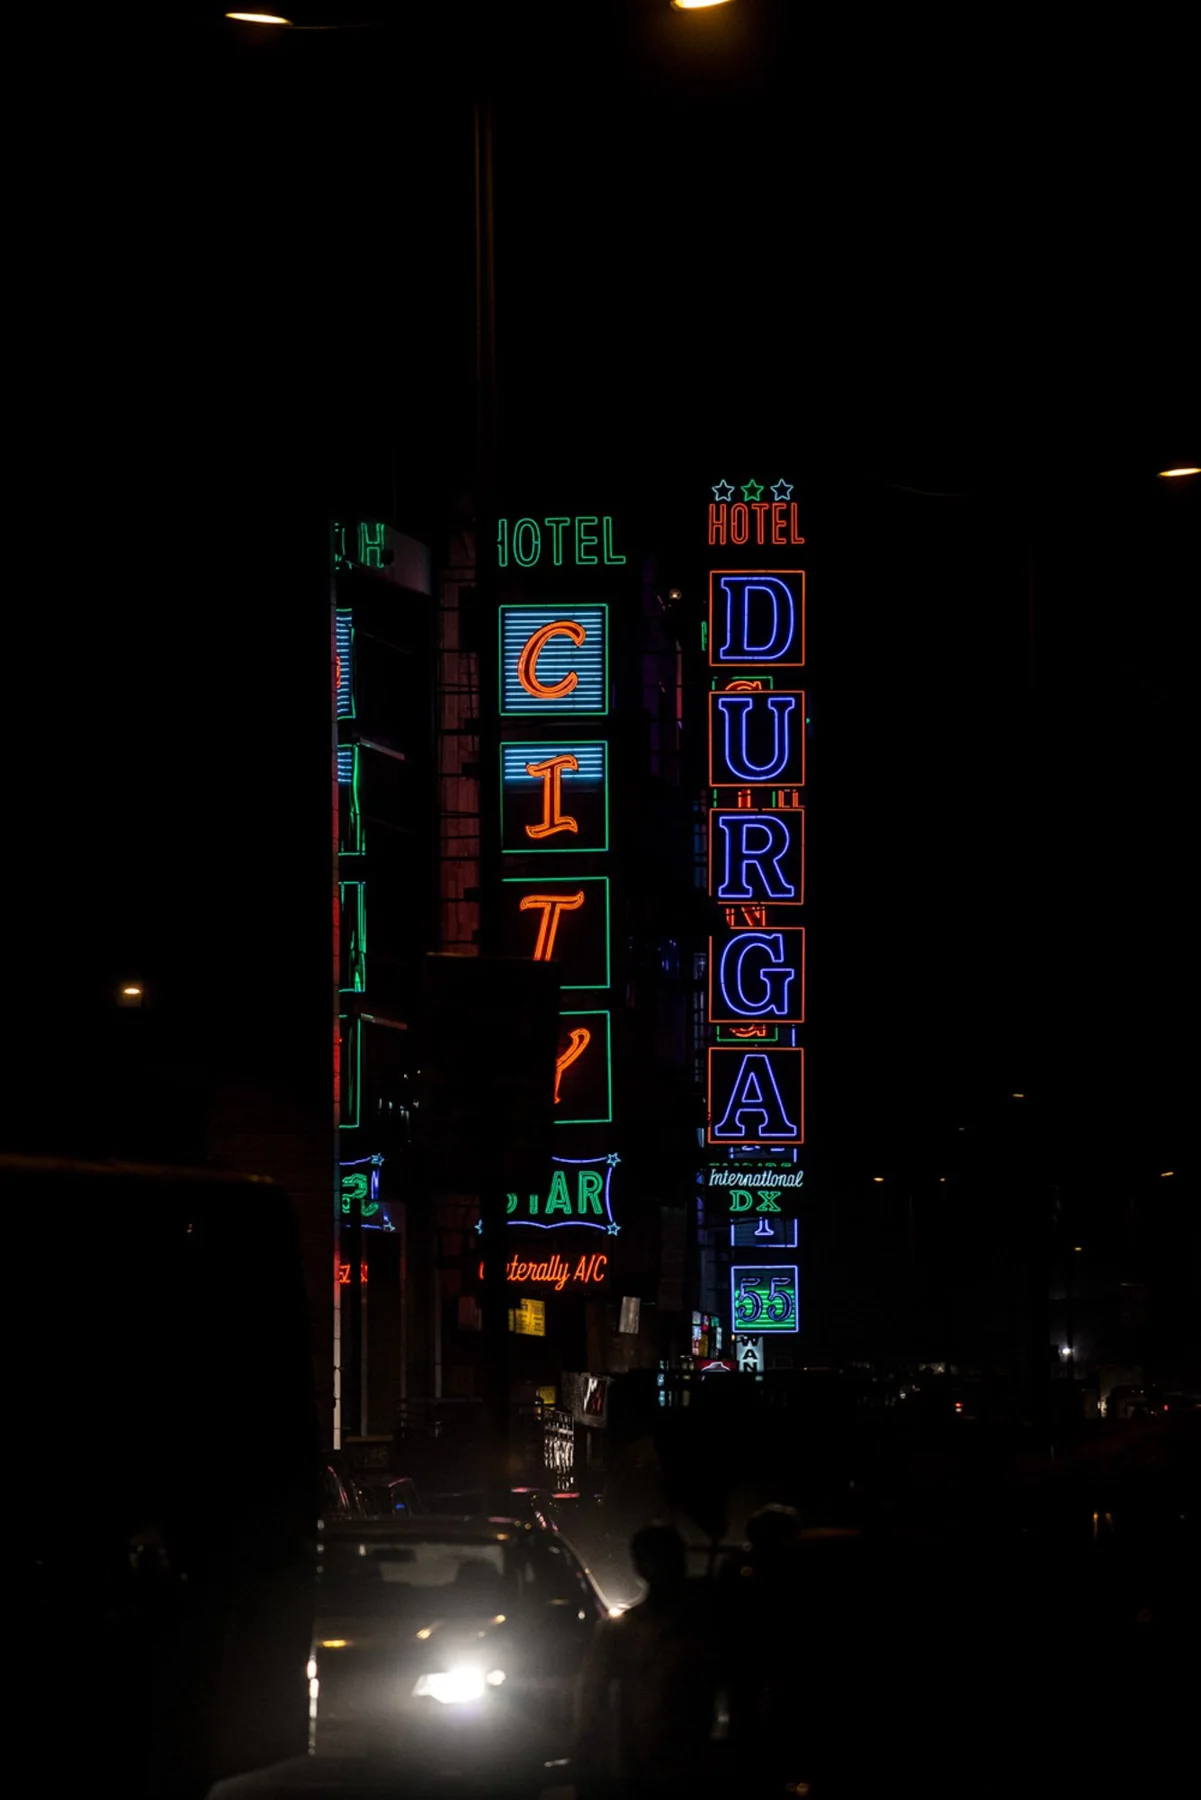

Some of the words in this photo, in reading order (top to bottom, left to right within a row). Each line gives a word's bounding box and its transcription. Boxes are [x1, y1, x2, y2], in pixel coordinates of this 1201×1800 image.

[708, 502, 805, 545] HOTEL
[714, 576, 798, 1137] DURGA
[708, 1168, 804, 1188] International
[478, 1254, 571, 1291] terally
[572, 1254, 608, 1284] A/C
[737, 1277, 792, 1322] 55
